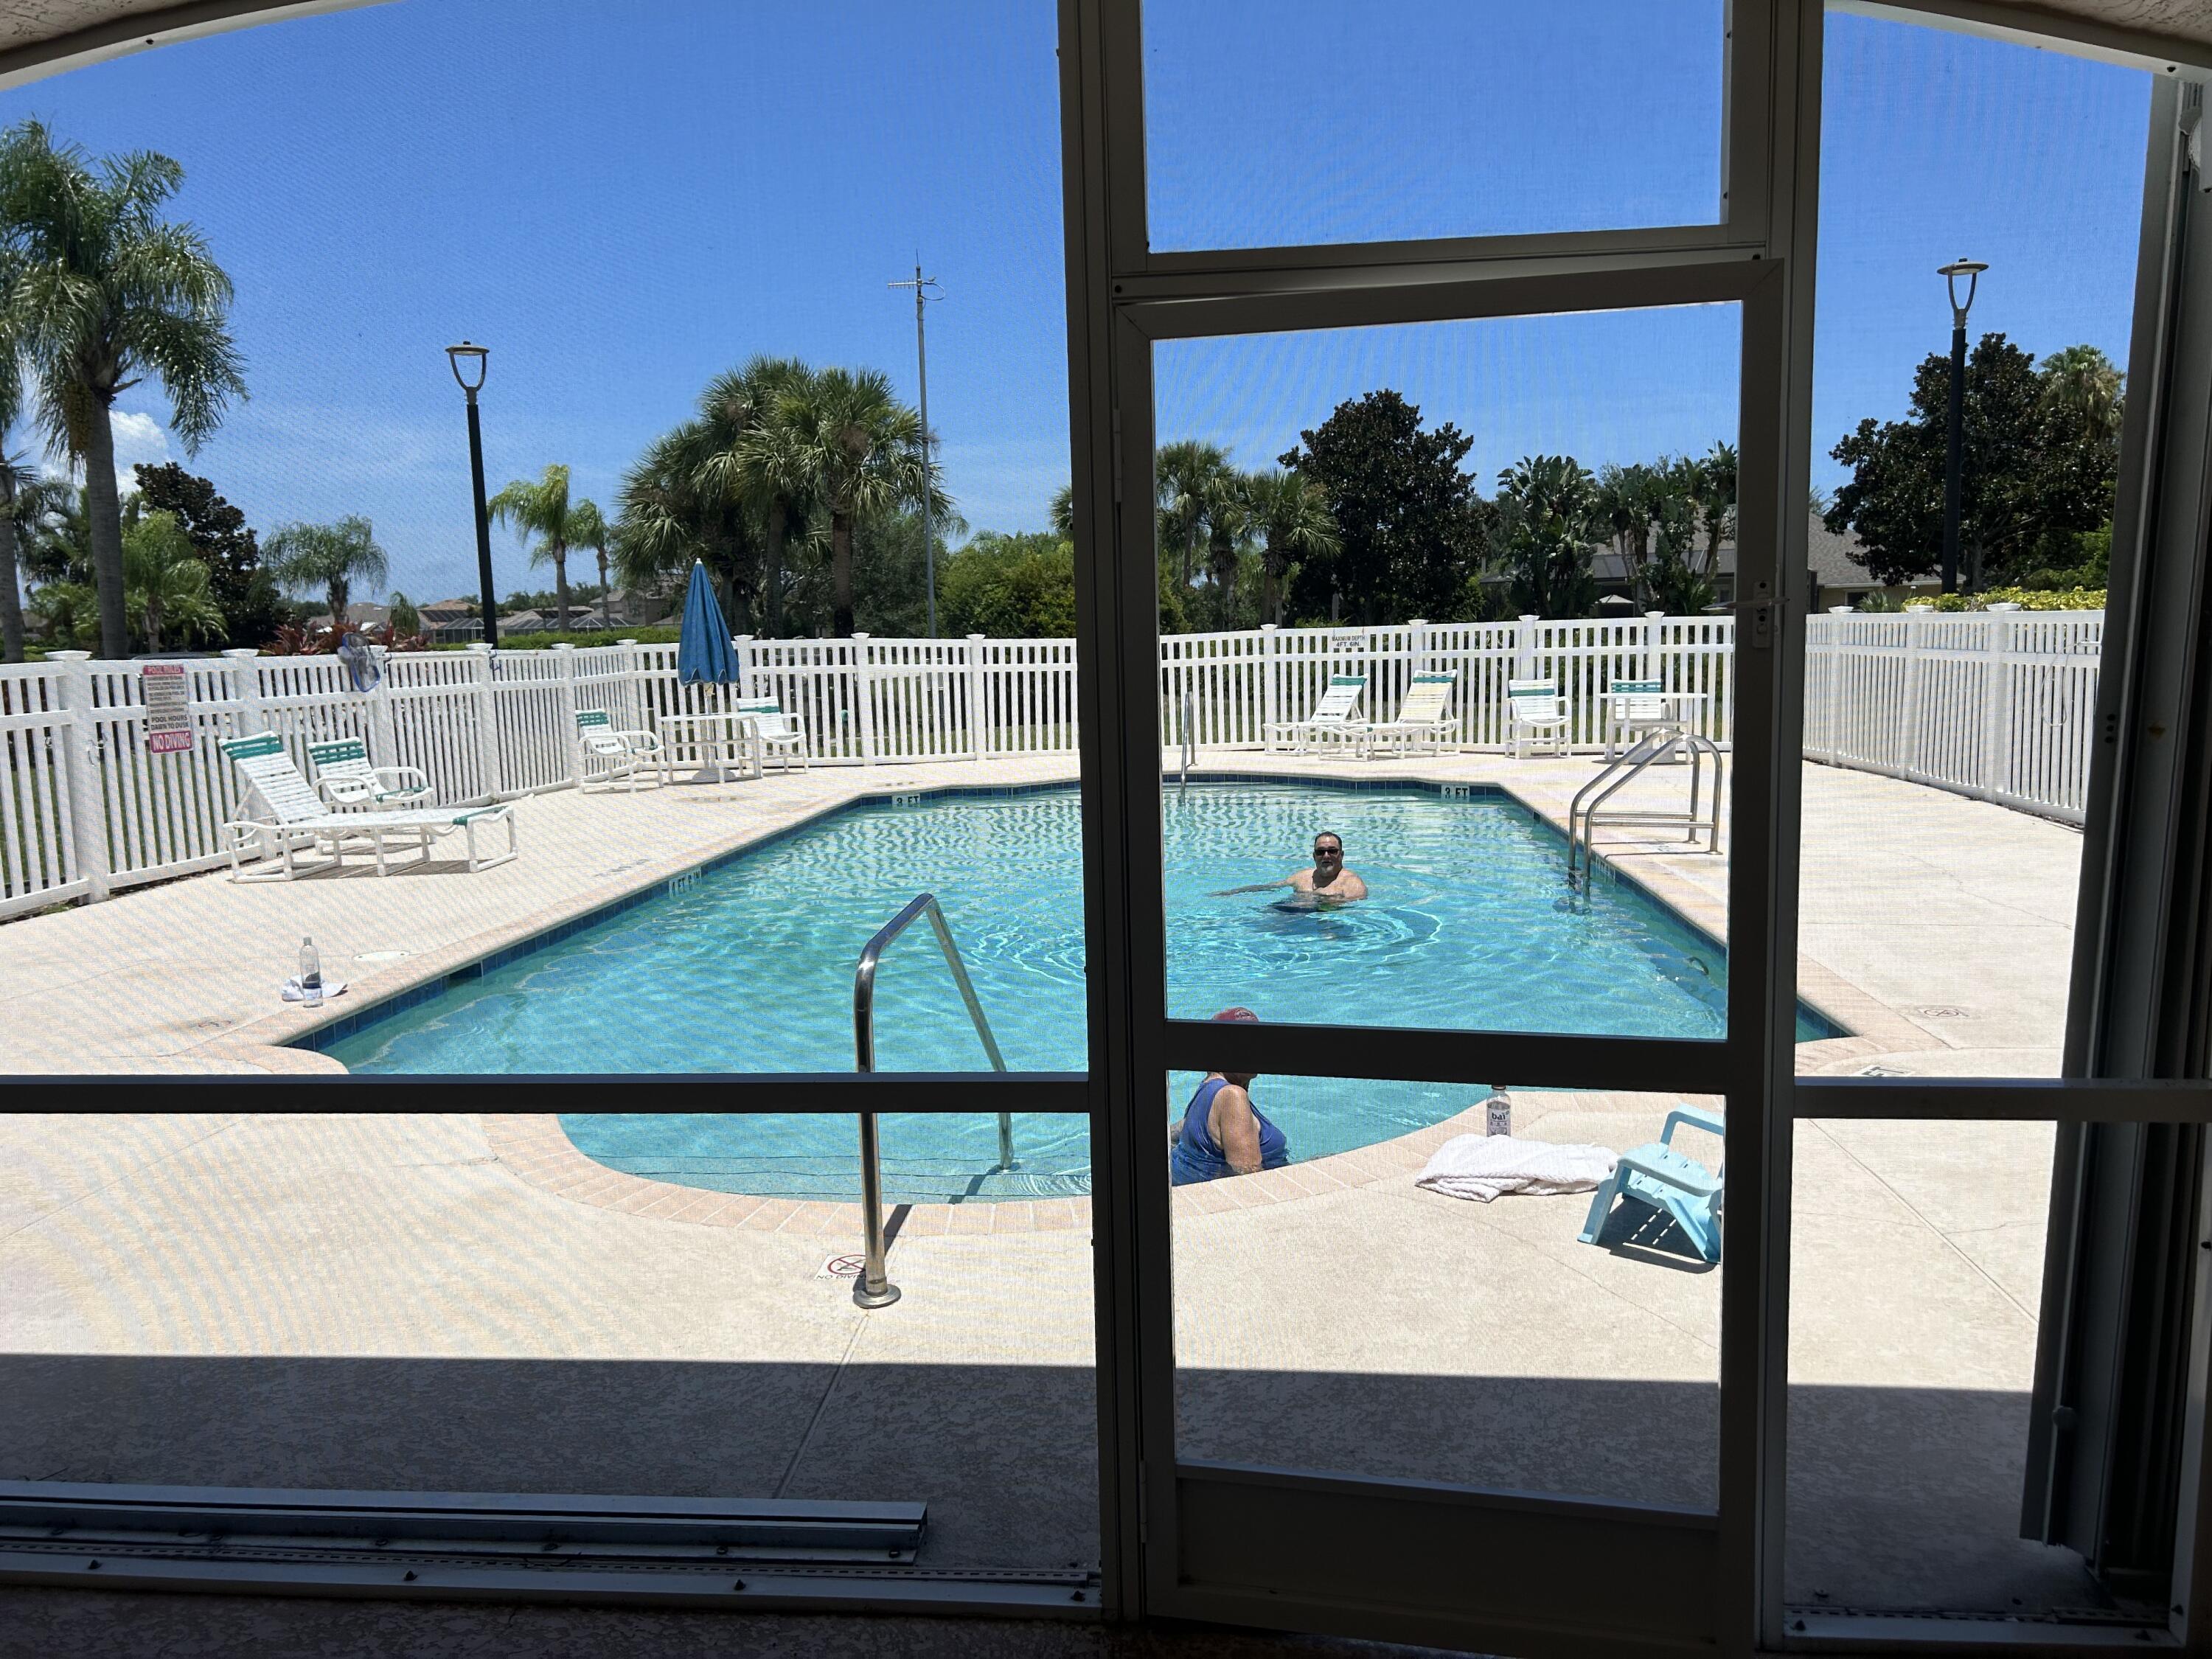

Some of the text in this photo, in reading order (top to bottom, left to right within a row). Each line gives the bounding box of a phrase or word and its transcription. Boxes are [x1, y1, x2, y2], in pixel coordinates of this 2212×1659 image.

[147, 665, 181, 674] POOL RULES
[168, 714, 187, 723] HOURS
[153, 731, 190, 751] NO DIVING
[1492, 1112, 1506, 1121] bai
